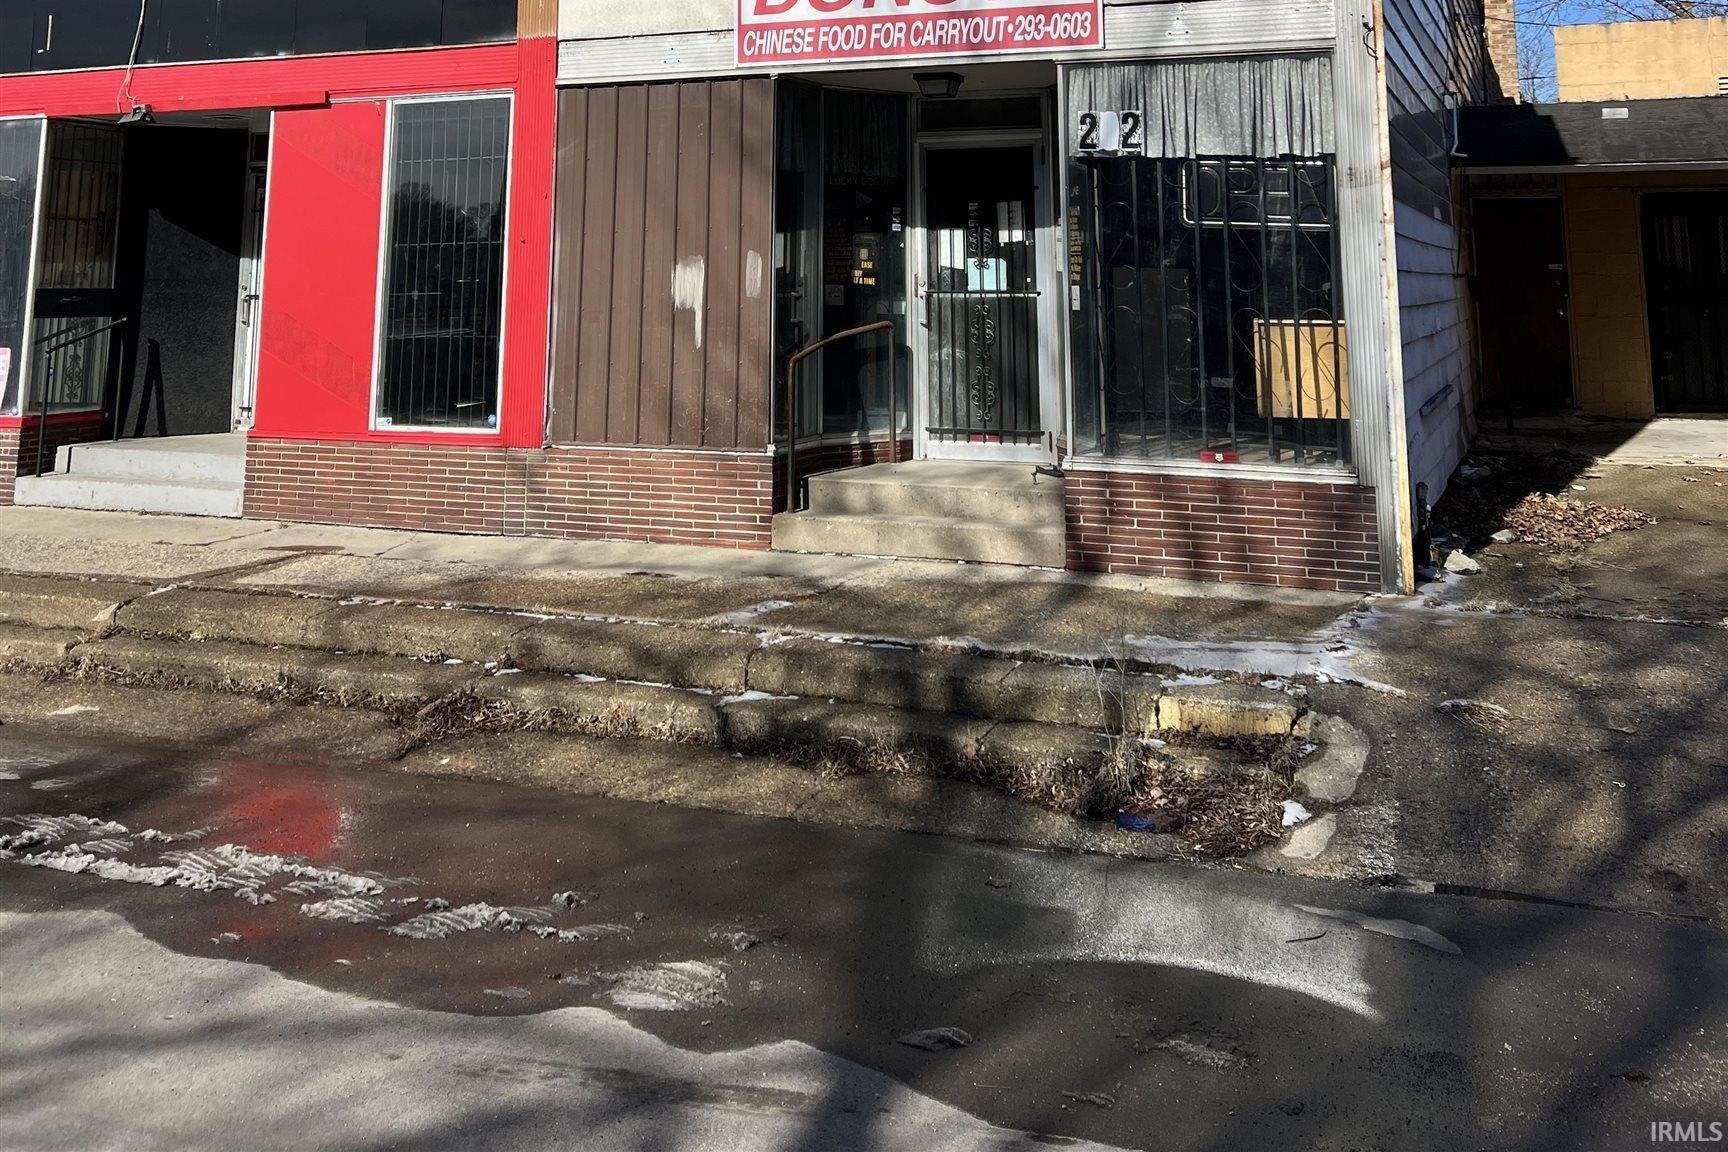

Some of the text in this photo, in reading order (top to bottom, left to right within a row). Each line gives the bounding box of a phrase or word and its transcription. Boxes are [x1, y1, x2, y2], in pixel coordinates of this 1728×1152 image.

[743, 28, 815, 56] CHINESE
[818, 25, 867, 50] FOOD
[870, 22, 906, 48] FOR
